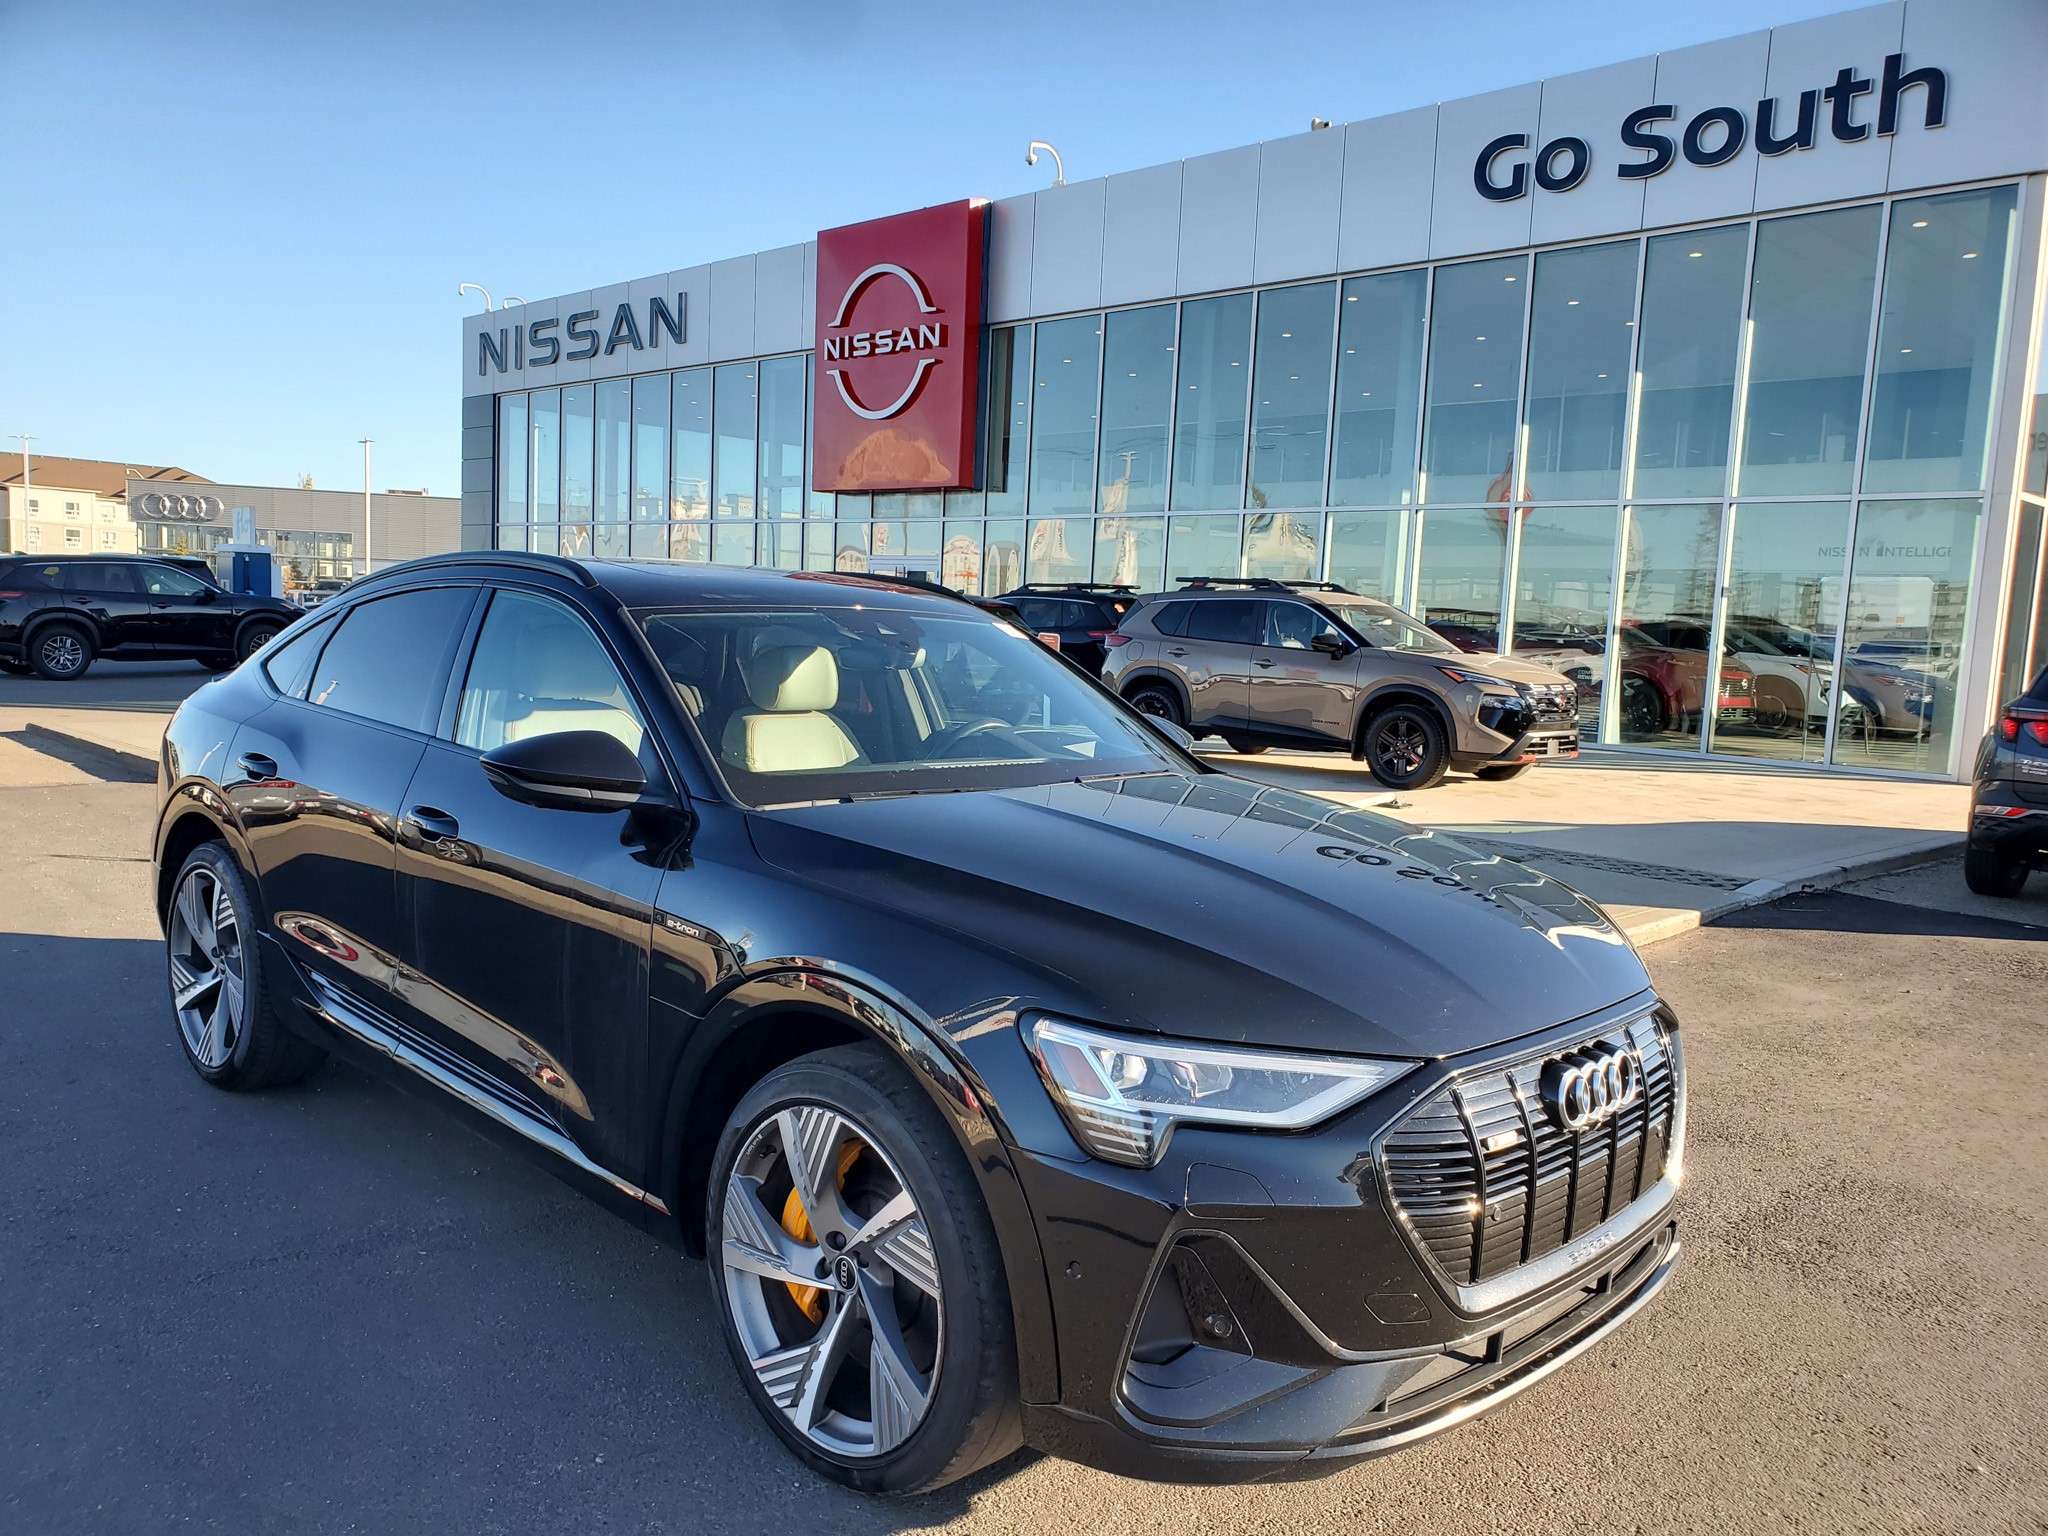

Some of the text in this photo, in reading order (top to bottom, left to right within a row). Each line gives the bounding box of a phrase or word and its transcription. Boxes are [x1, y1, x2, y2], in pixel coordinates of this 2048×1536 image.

[1474, 52, 1949, 203] Go South
[478, 292, 687, 376] NISSAN
[824, 322, 942, 361] NISSAN
[1818, 546, 1952, 558] NISSN NTELLIGE
[667, 919, 699, 937] e-tron
